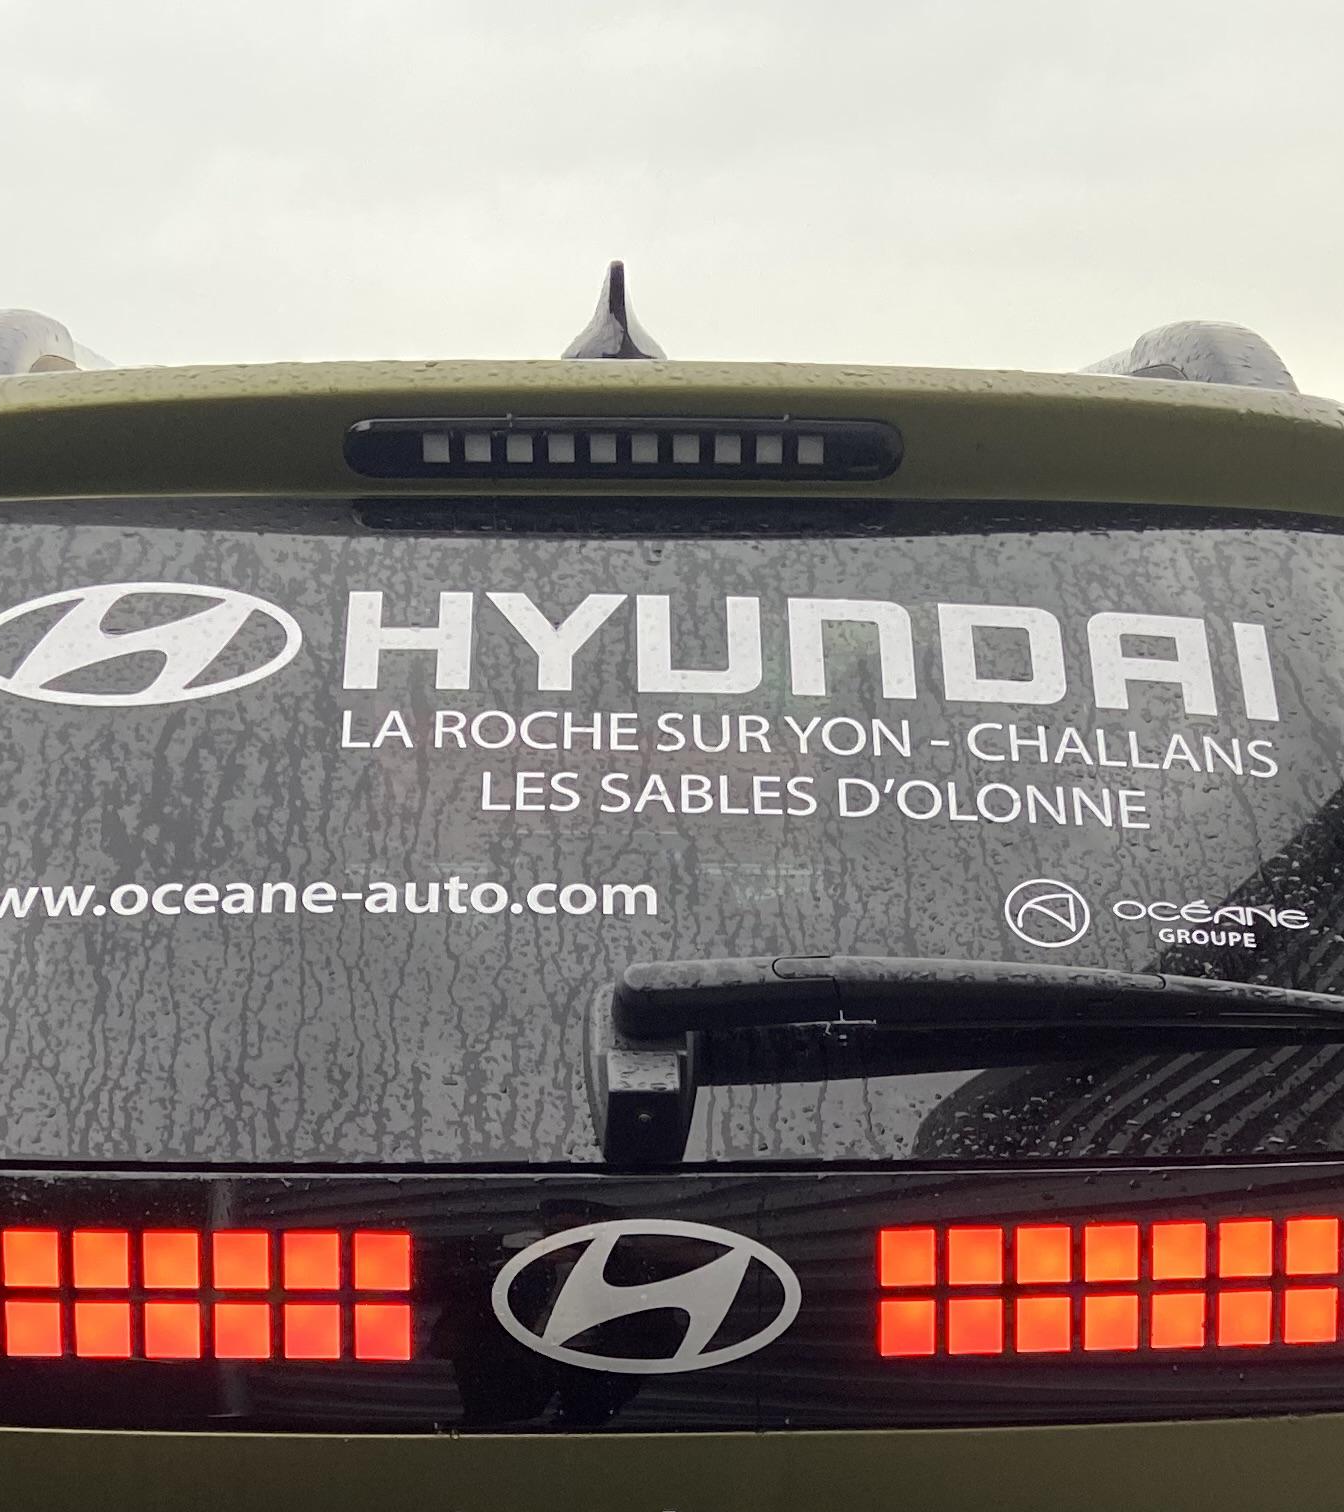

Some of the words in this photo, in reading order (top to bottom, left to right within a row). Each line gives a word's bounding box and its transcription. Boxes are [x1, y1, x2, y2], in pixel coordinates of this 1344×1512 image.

[342, 591, 1280, 722] HYUNDAI
[341, 710, 414, 748] LA
[434, 710, 639, 751] ROCHE
[656, 712, 772, 753] SUR
[783, 716, 911, 757] YON
[967, 722, 1278, 778] CHALLANS
[481, 771, 581, 812] LES
[600, 772, 817, 816] SABLES
[838, 778, 1150, 829] D'OLONNE
[1112, 899, 1311, 929] OCÉANE
[1158, 928, 1257, 948] GROUPE
